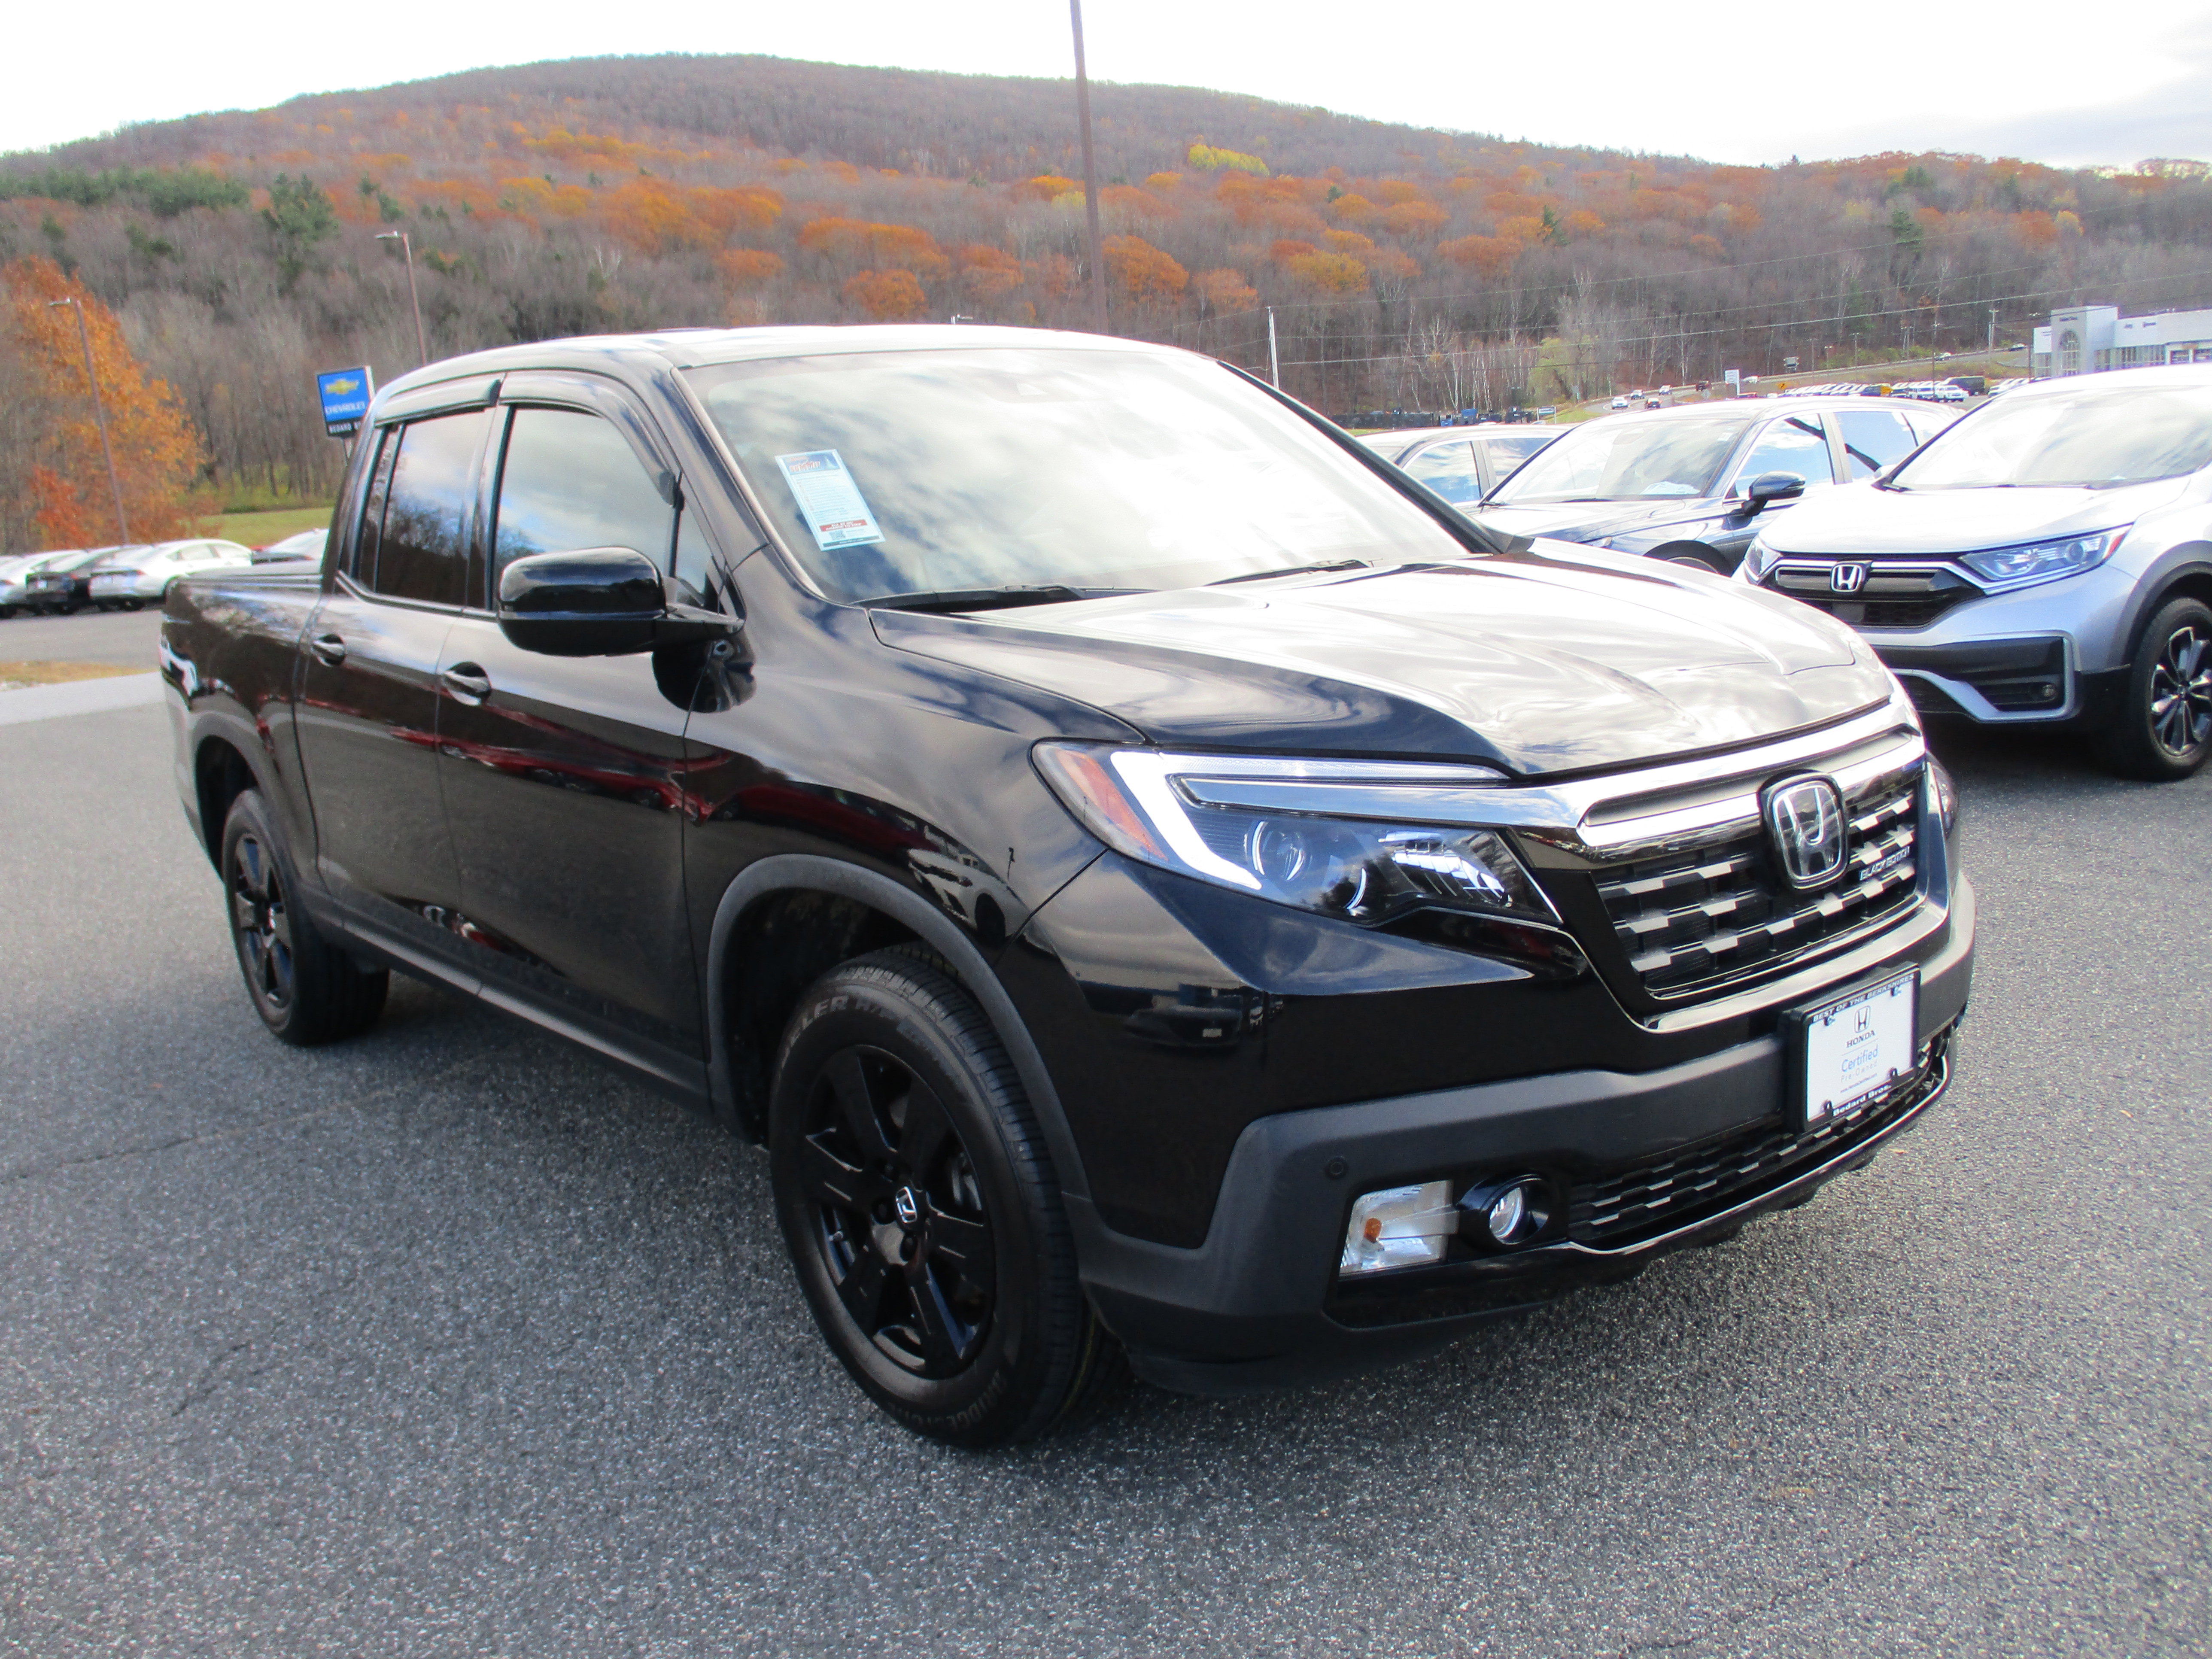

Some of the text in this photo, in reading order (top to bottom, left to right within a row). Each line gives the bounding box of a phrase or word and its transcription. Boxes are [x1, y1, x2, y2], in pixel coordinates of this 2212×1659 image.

[1813, 1008, 1835, 1023] BEST
[1836, 1001, 1848, 1012] OF
[1849, 994, 1866, 1006] THE
[1846, 1030, 1875, 1048] HONDA
[1841, 1043, 1878, 1073] Certified
[1841, 1060, 1878, 1082] Pre-Owned
[1833, 1095, 1866, 1116] Bedard
